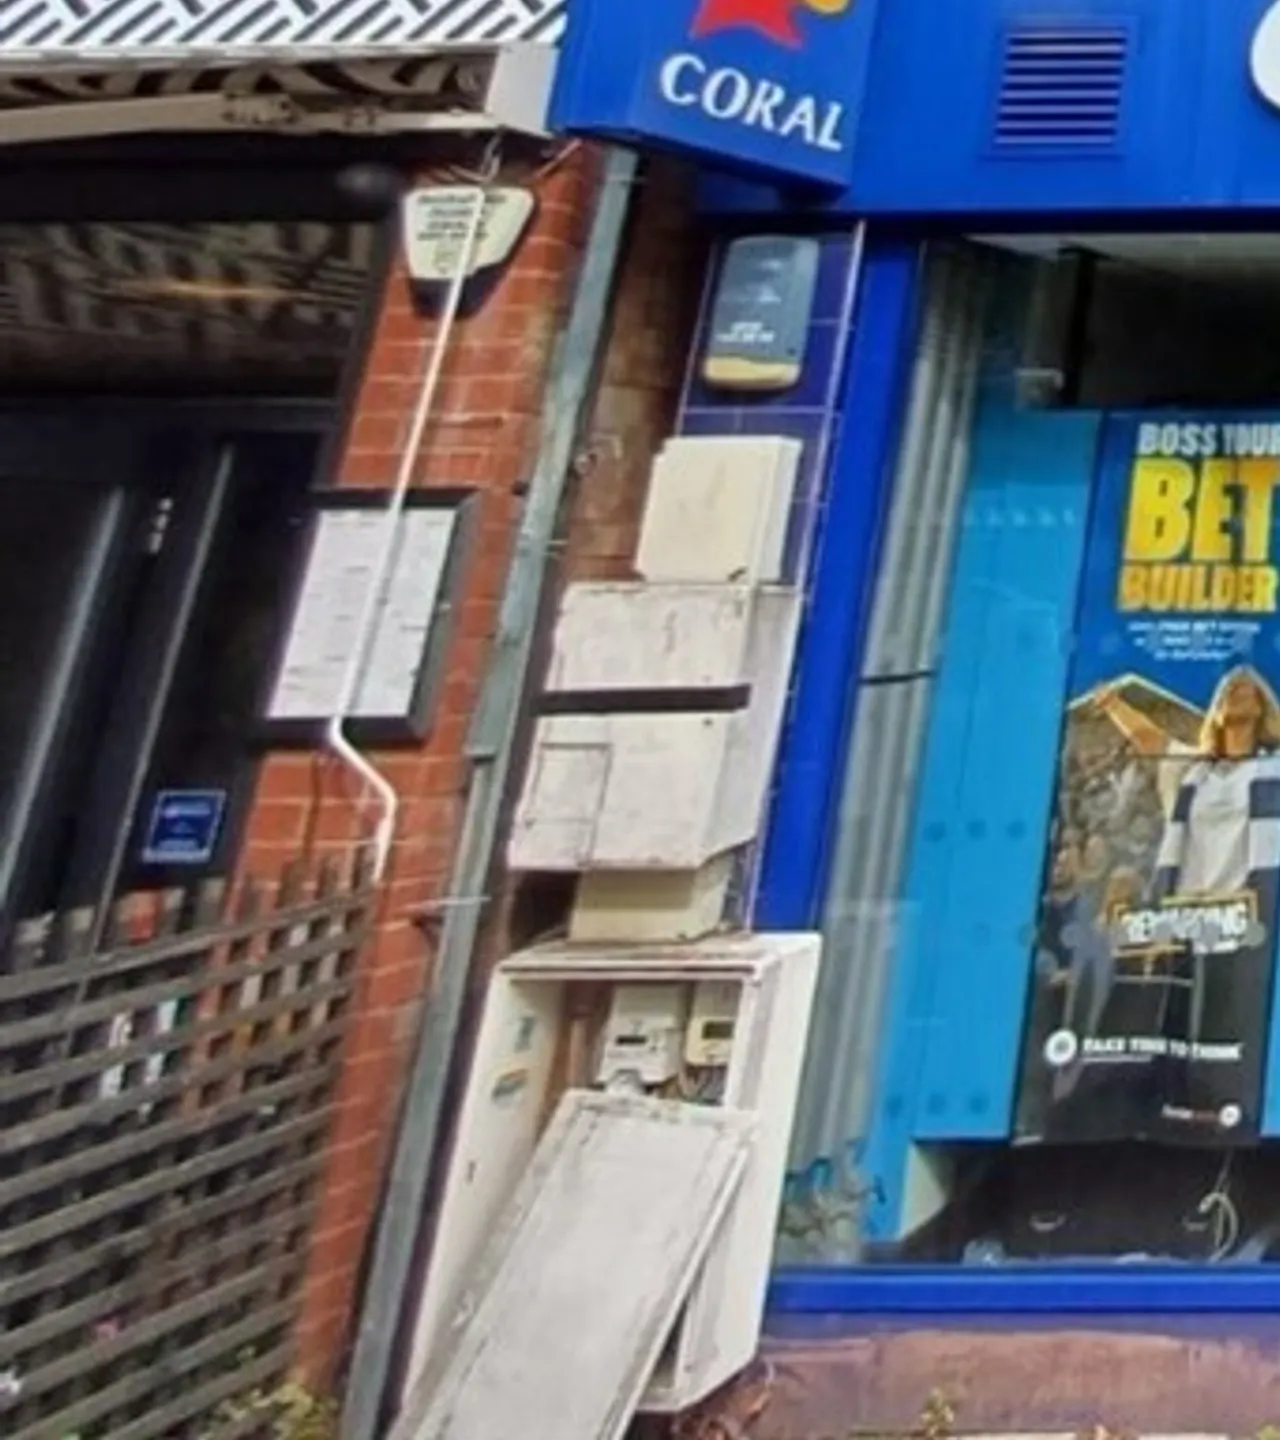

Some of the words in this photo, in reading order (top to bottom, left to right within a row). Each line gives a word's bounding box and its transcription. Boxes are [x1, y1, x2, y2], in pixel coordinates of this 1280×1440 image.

[660, 52, 844, 152] CORAL
[1137, 422, 1218, 456] BOSS
[1116, 564, 1280, 614] BUILDER
[1170, 1038, 1188, 1057] TO
